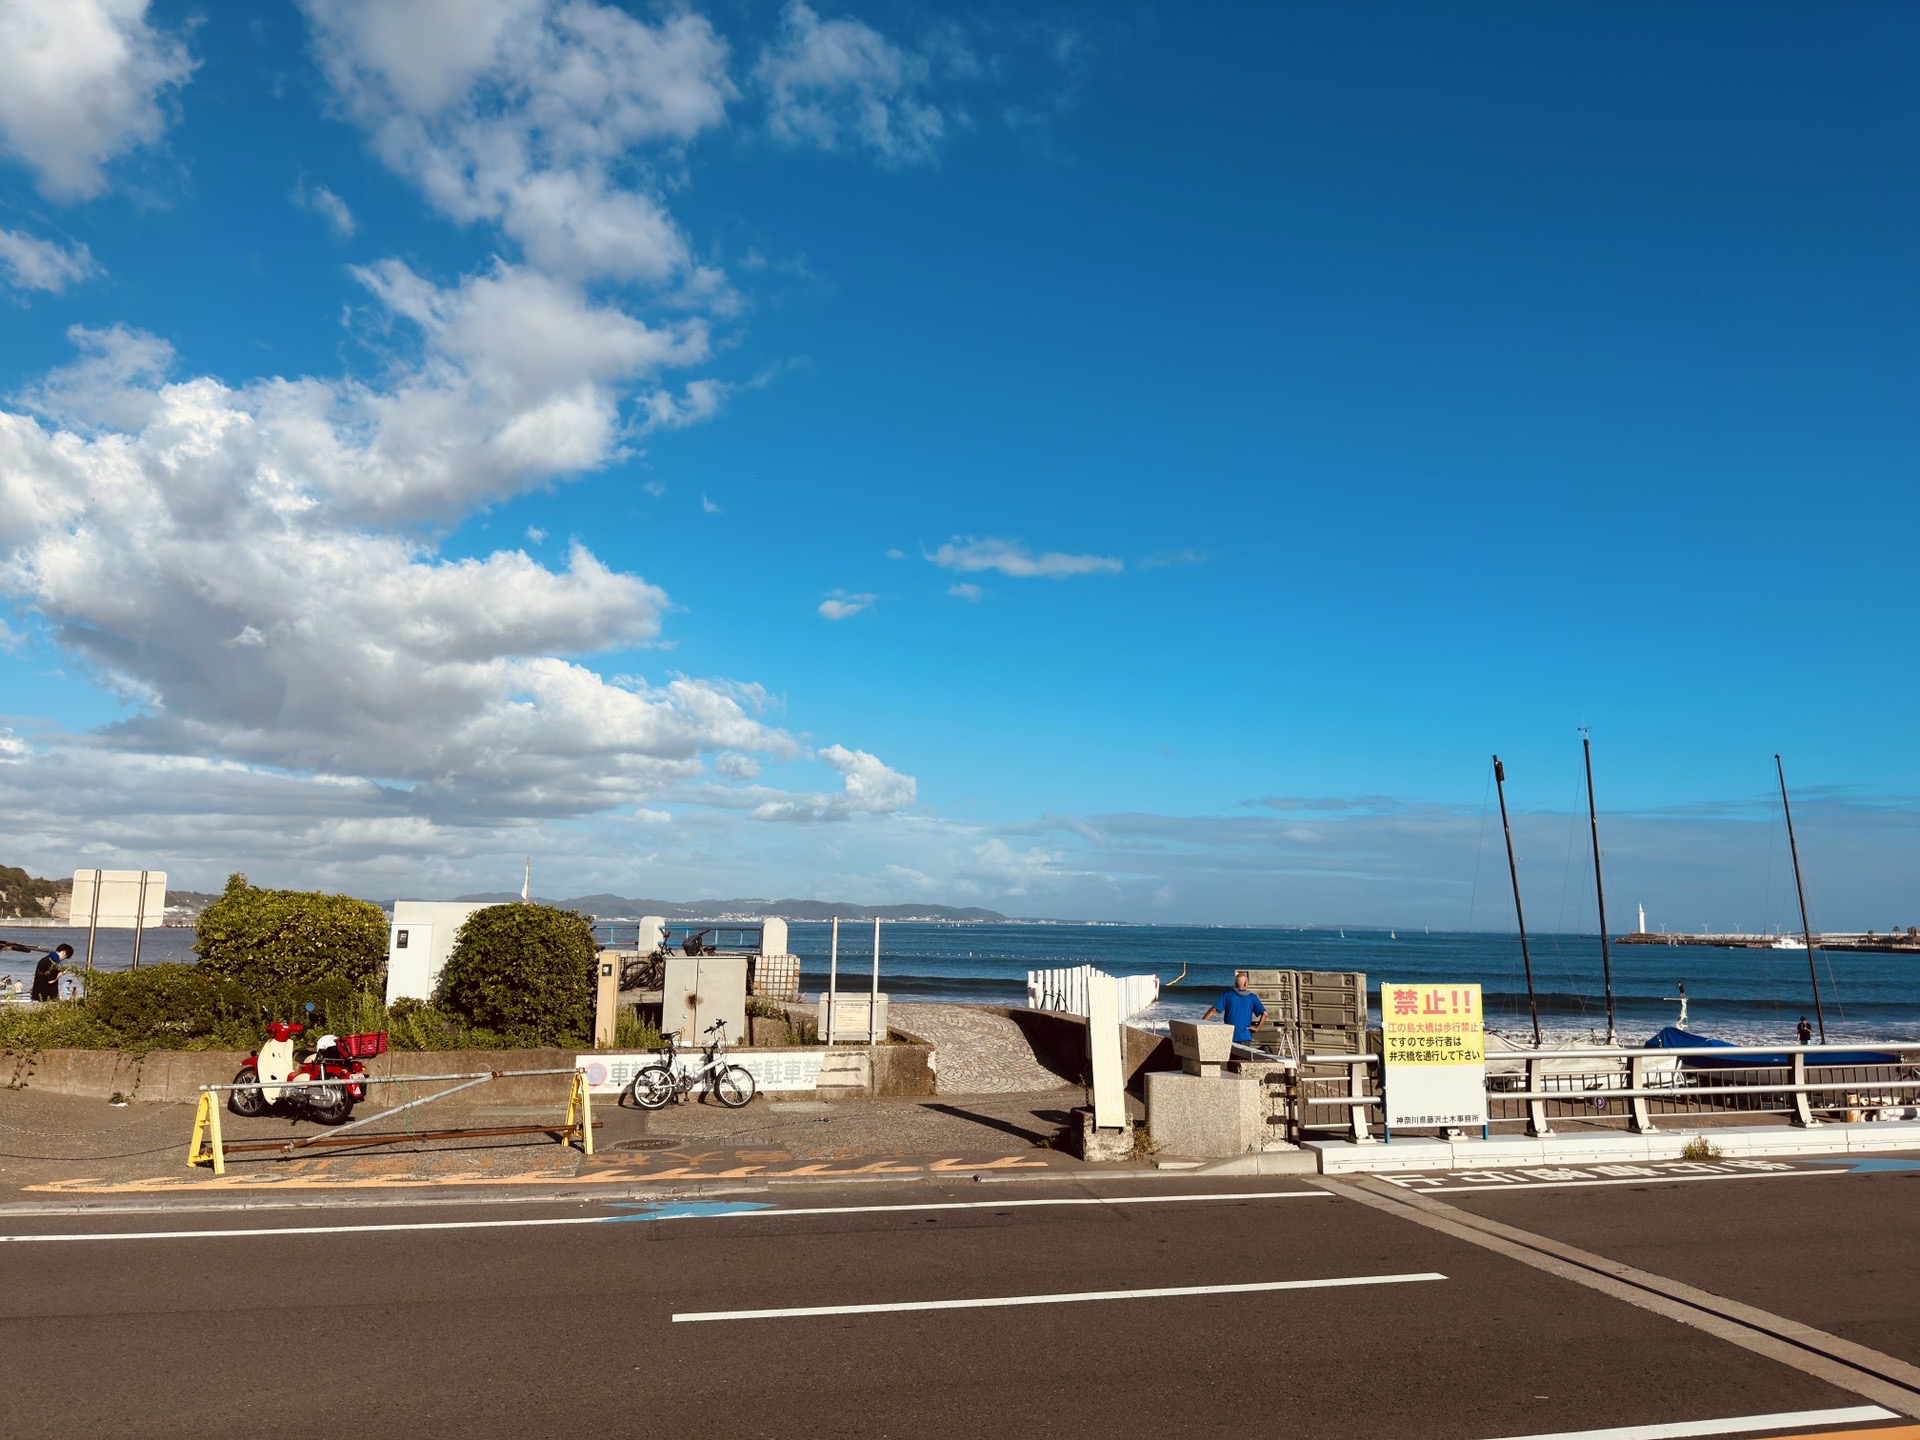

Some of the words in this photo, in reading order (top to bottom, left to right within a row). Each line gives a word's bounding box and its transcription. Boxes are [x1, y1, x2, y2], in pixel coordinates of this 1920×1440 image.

[1393, 989, 1471, 1015] 禁止!!
[1387, 1022, 1479, 1033] 江の島大橋は歩行禁止
[1388, 1037, 1462, 1048] ですので歩行者は
[1389, 1050, 1480, 1062] 弁天橋を通行して下さい
[1396, 1114, 1479, 1125] 神奈川県藤沢土木事務所
